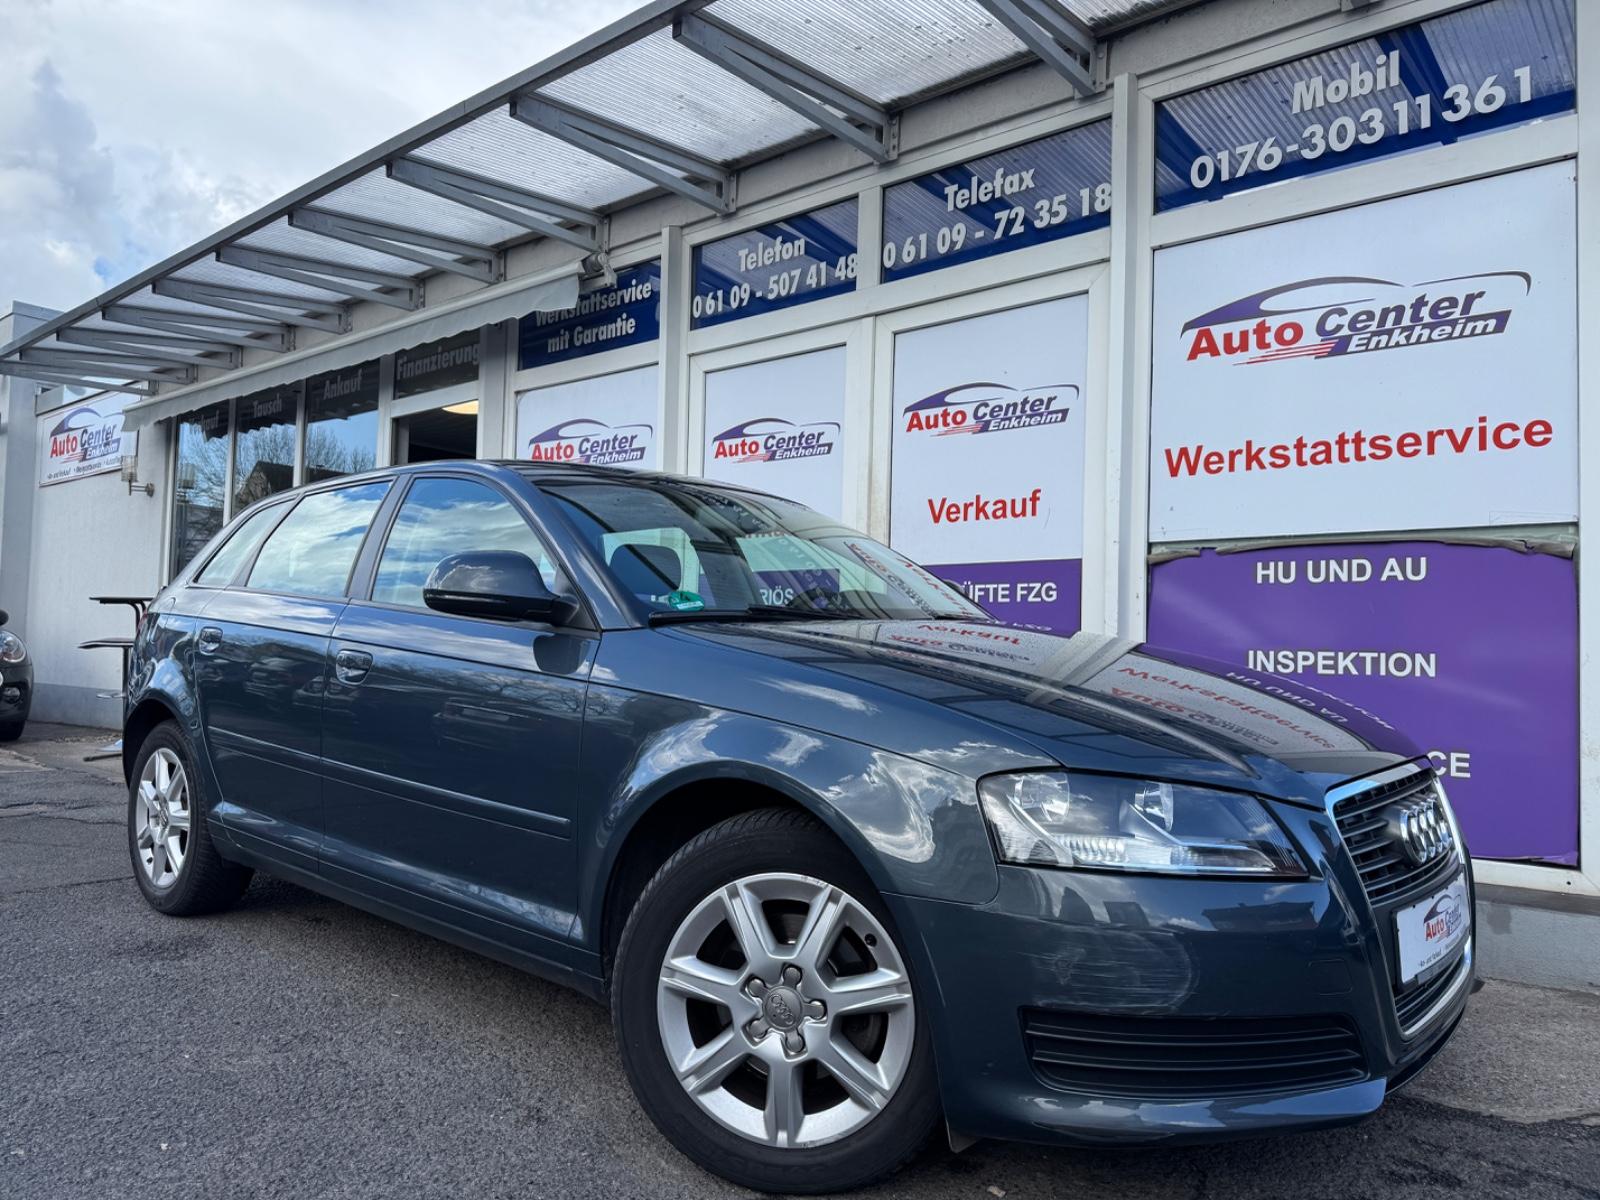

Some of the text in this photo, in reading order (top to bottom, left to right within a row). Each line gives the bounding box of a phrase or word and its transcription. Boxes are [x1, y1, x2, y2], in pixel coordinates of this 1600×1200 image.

[1291, 50, 1400, 114] Mobil
[944, 168, 1036, 212] Telefax
[937, 222, 967, 255] 09
[994, 205, 1025, 240] 72
[1034, 194, 1068, 229] 35
[1079, 182, 1112, 217] 18
[738, 236, 806, 273] Telefon
[730, 282, 751, 309] 09
[767, 268, 802, 300] 507
[806, 261, 828, 288] 41
[834, 253, 858, 281] 48
[547, 312, 637, 354] mit Garantie
[1187, 290, 1487, 361] Auto Center
[1346, 315, 1497, 354] Enkheim
[397, 343, 480, 380] Finanzierung
[323, 368, 362, 401] Ankauf
[252, 393, 283, 418] Tausch
[906, 395, 1058, 433] Auto Center
[988, 411, 1063, 431] Enkheim
[50, 424, 117, 459] Auto Center
[531, 432, 638, 463] Auto Center
[590, 448, 641, 464] Enkheim
[714, 429, 825, 460] Auto Center
[775, 444, 829, 461] Enkheim
[1164, 416, 1553, 478] Werkstattservice
[927, 488, 1042, 524] Verkauf
[1256, 557, 1427, 584] HU UND AU
[1017, 582, 1058, 602] FZG
[1247, 650, 1436, 678] INSPEKTION
[1425, 917, 1444, 942] Auto
